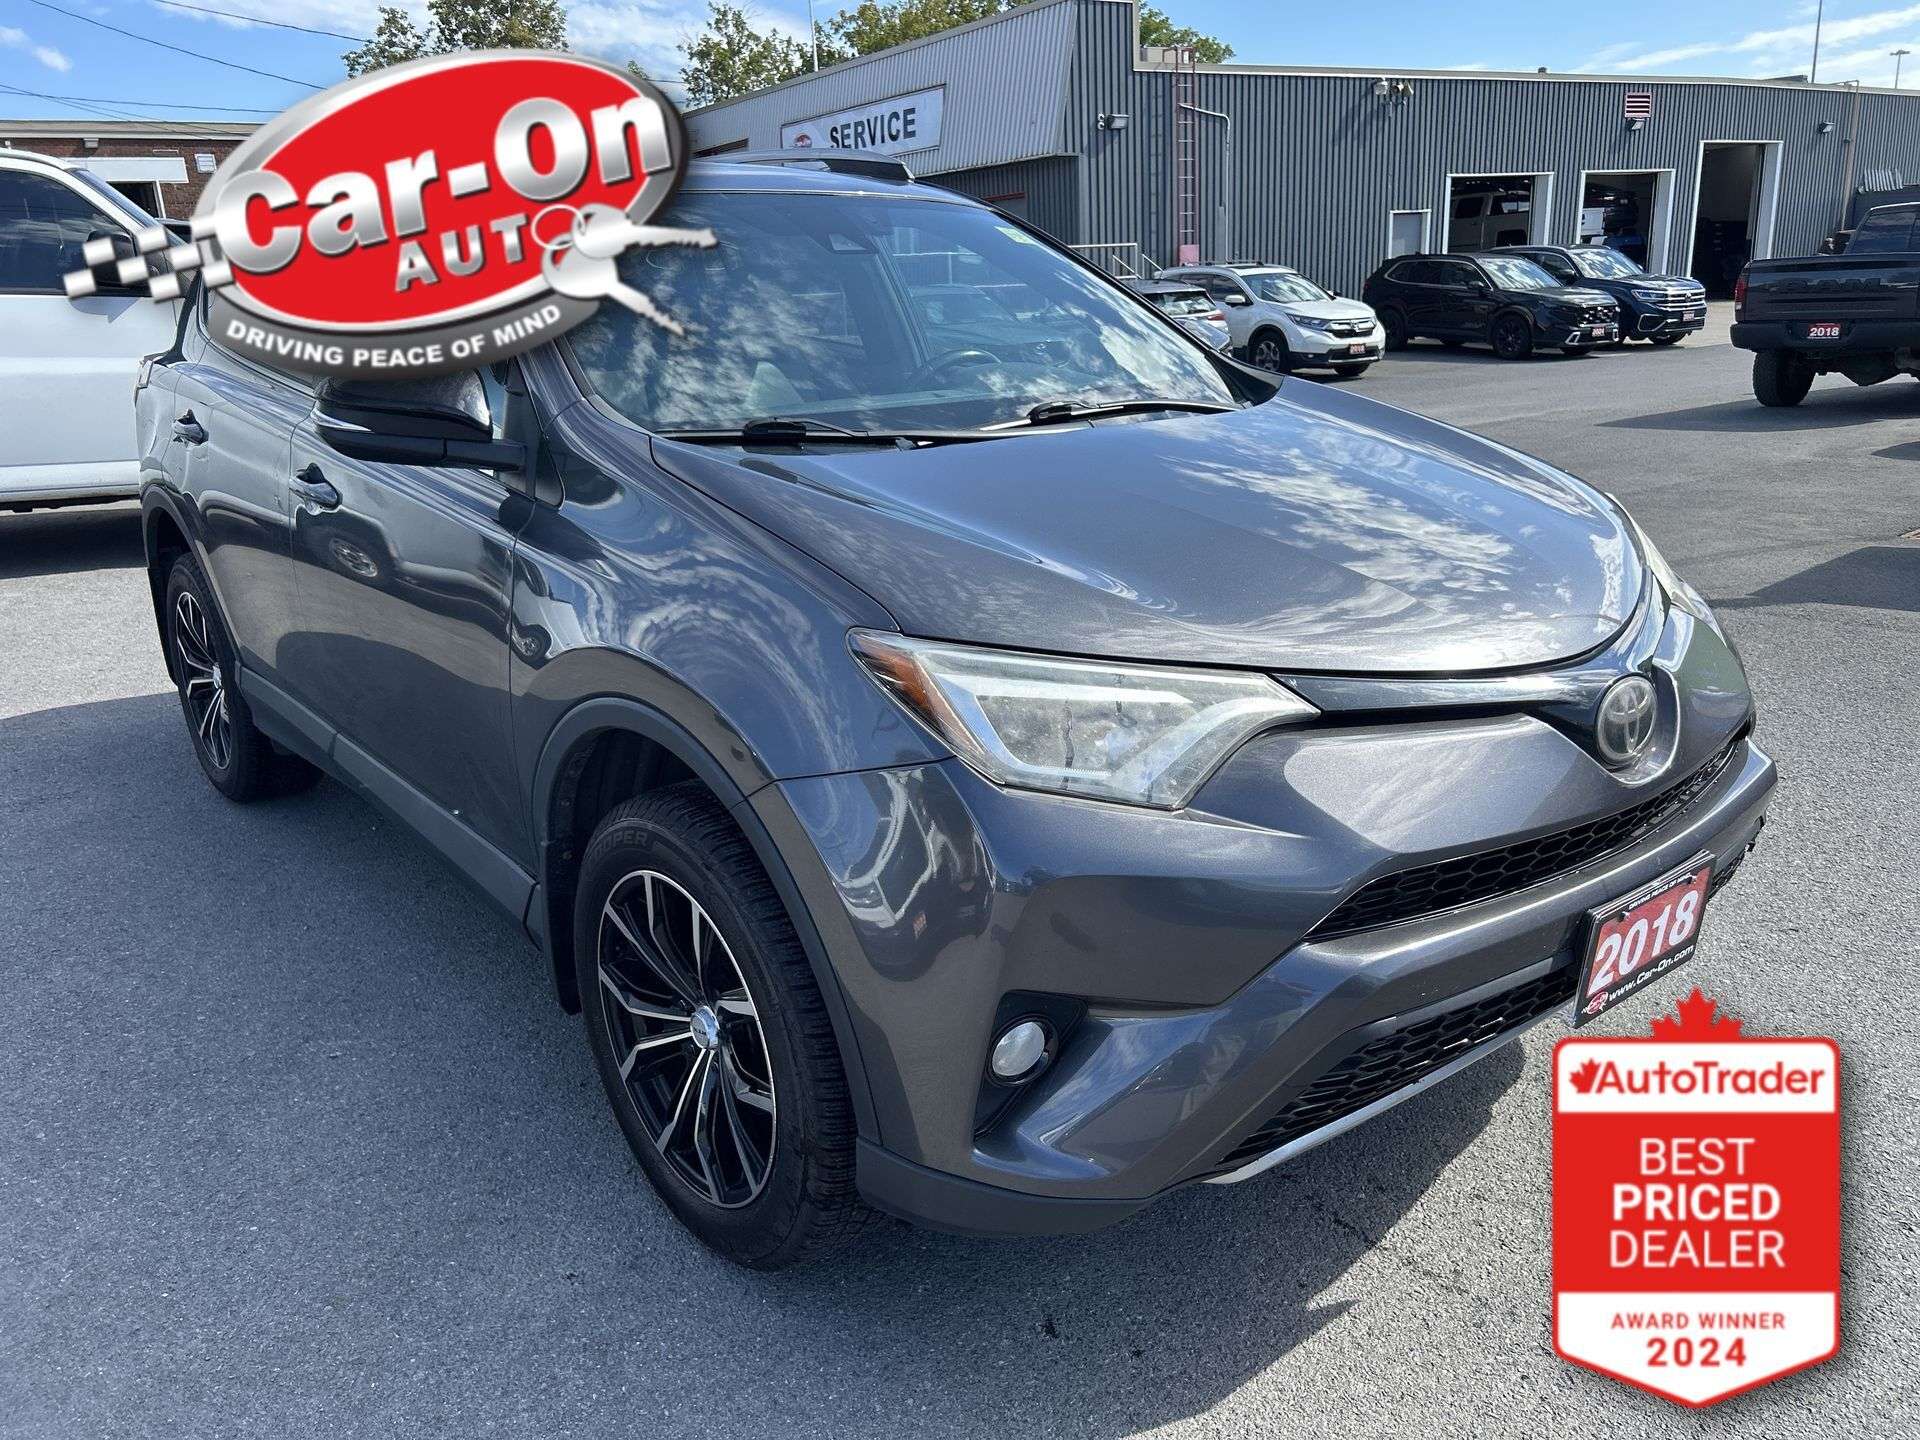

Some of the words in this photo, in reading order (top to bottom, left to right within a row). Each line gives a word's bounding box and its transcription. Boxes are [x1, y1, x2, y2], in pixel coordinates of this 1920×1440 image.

[830, 107, 917, 149] SERVICE
[1809, 327, 1840, 337] 2018
[1586, 889, 1699, 999] 2018
[1608, 944, 1694, 1001] www.Car-On.com
